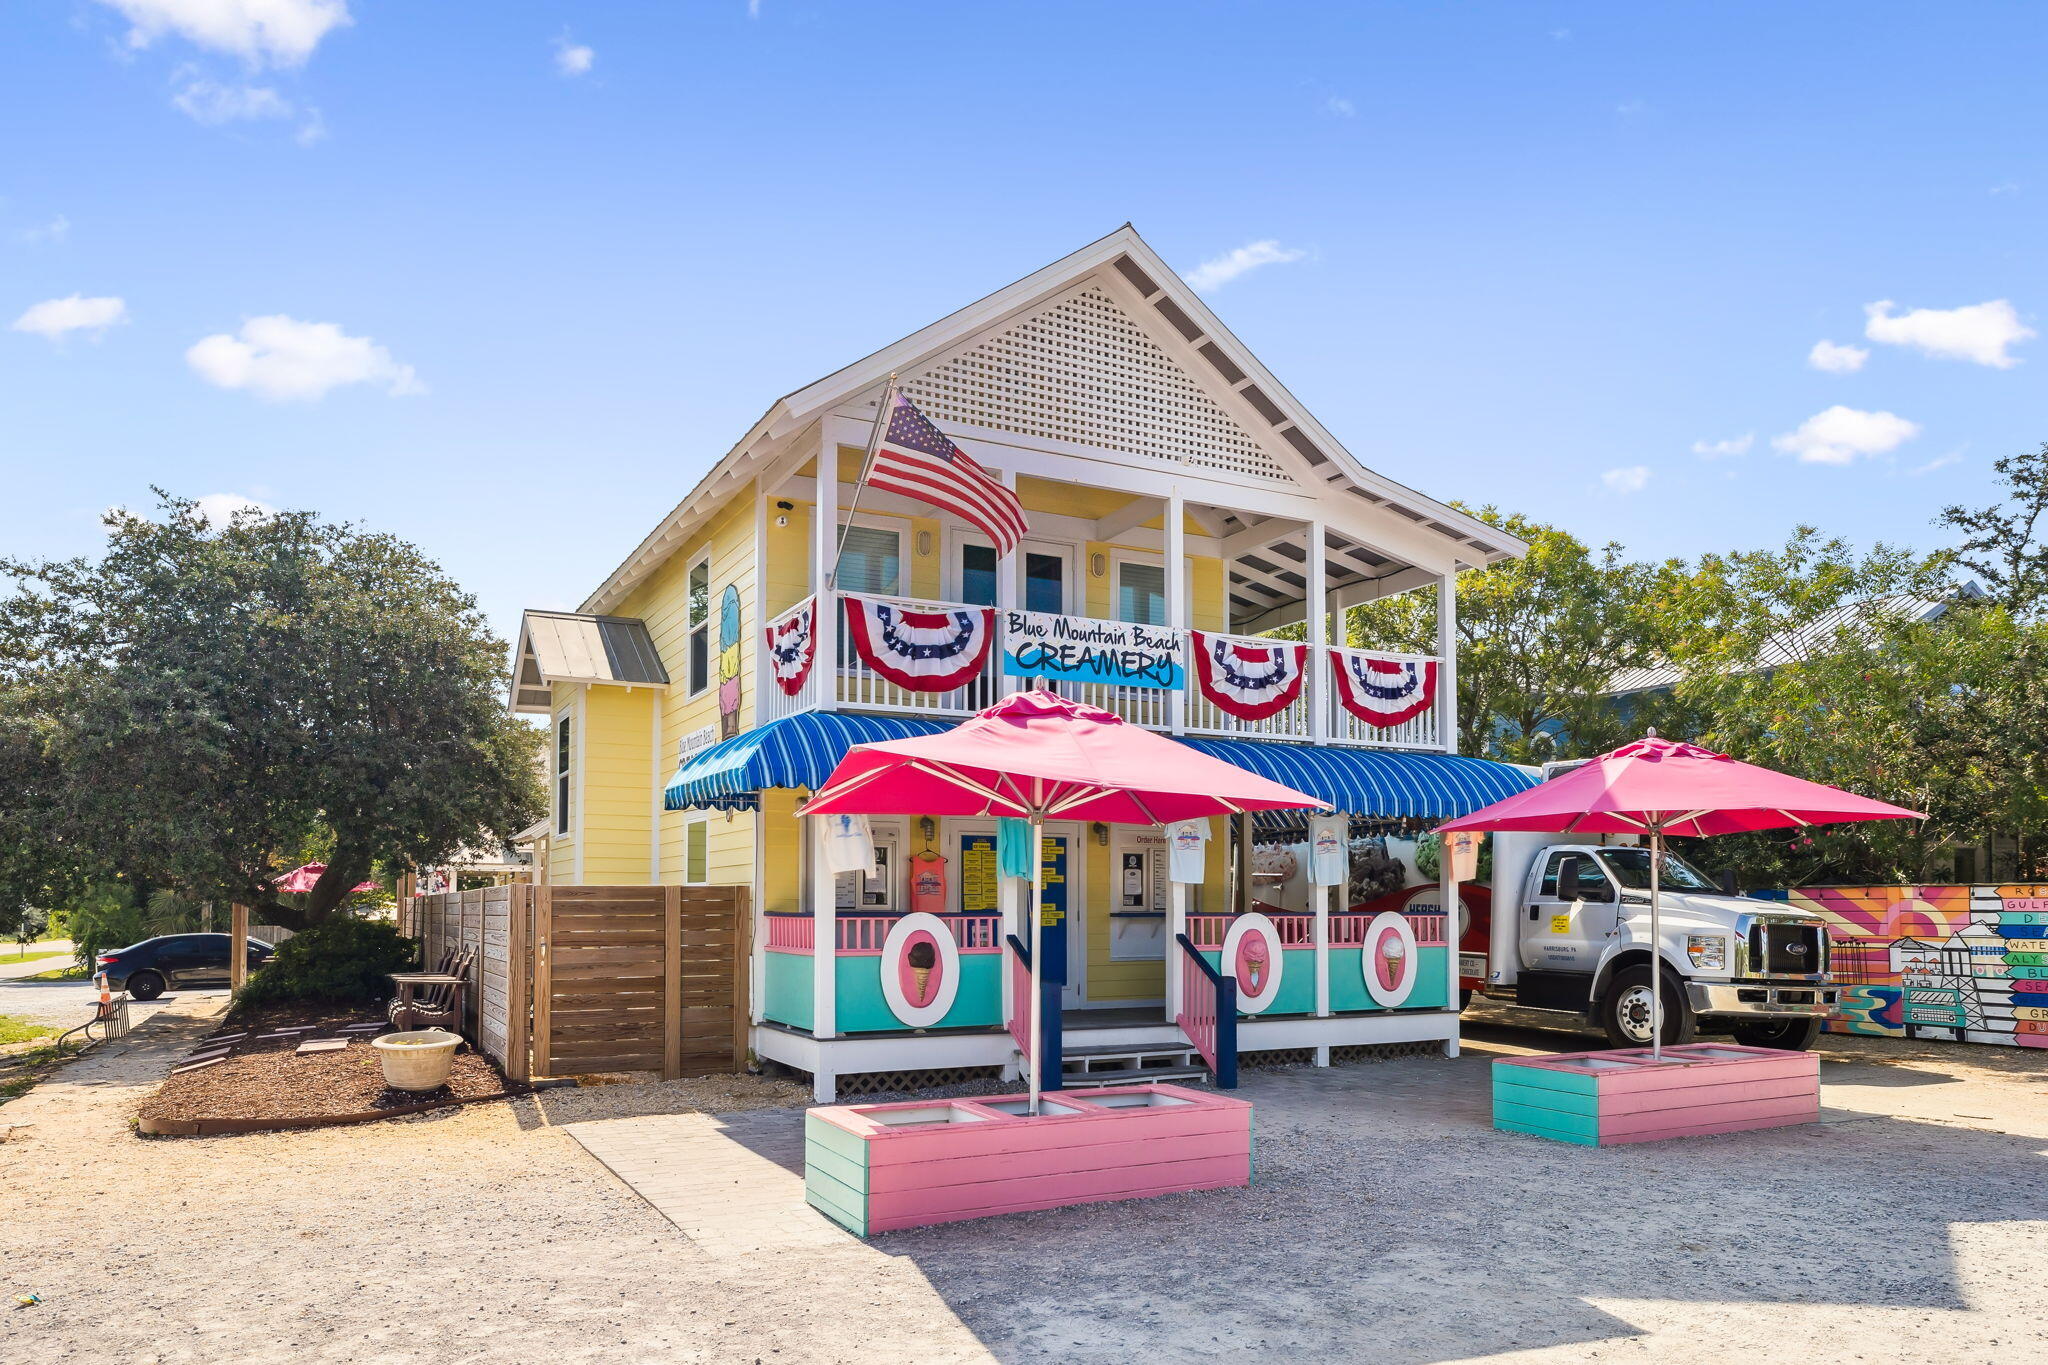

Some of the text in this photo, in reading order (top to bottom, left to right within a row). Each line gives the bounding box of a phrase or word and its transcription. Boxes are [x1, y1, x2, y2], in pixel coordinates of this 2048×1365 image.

[1007, 612, 1181, 652] Blue Mountain Beach
[1015, 641, 1174, 687] CREAMERY
